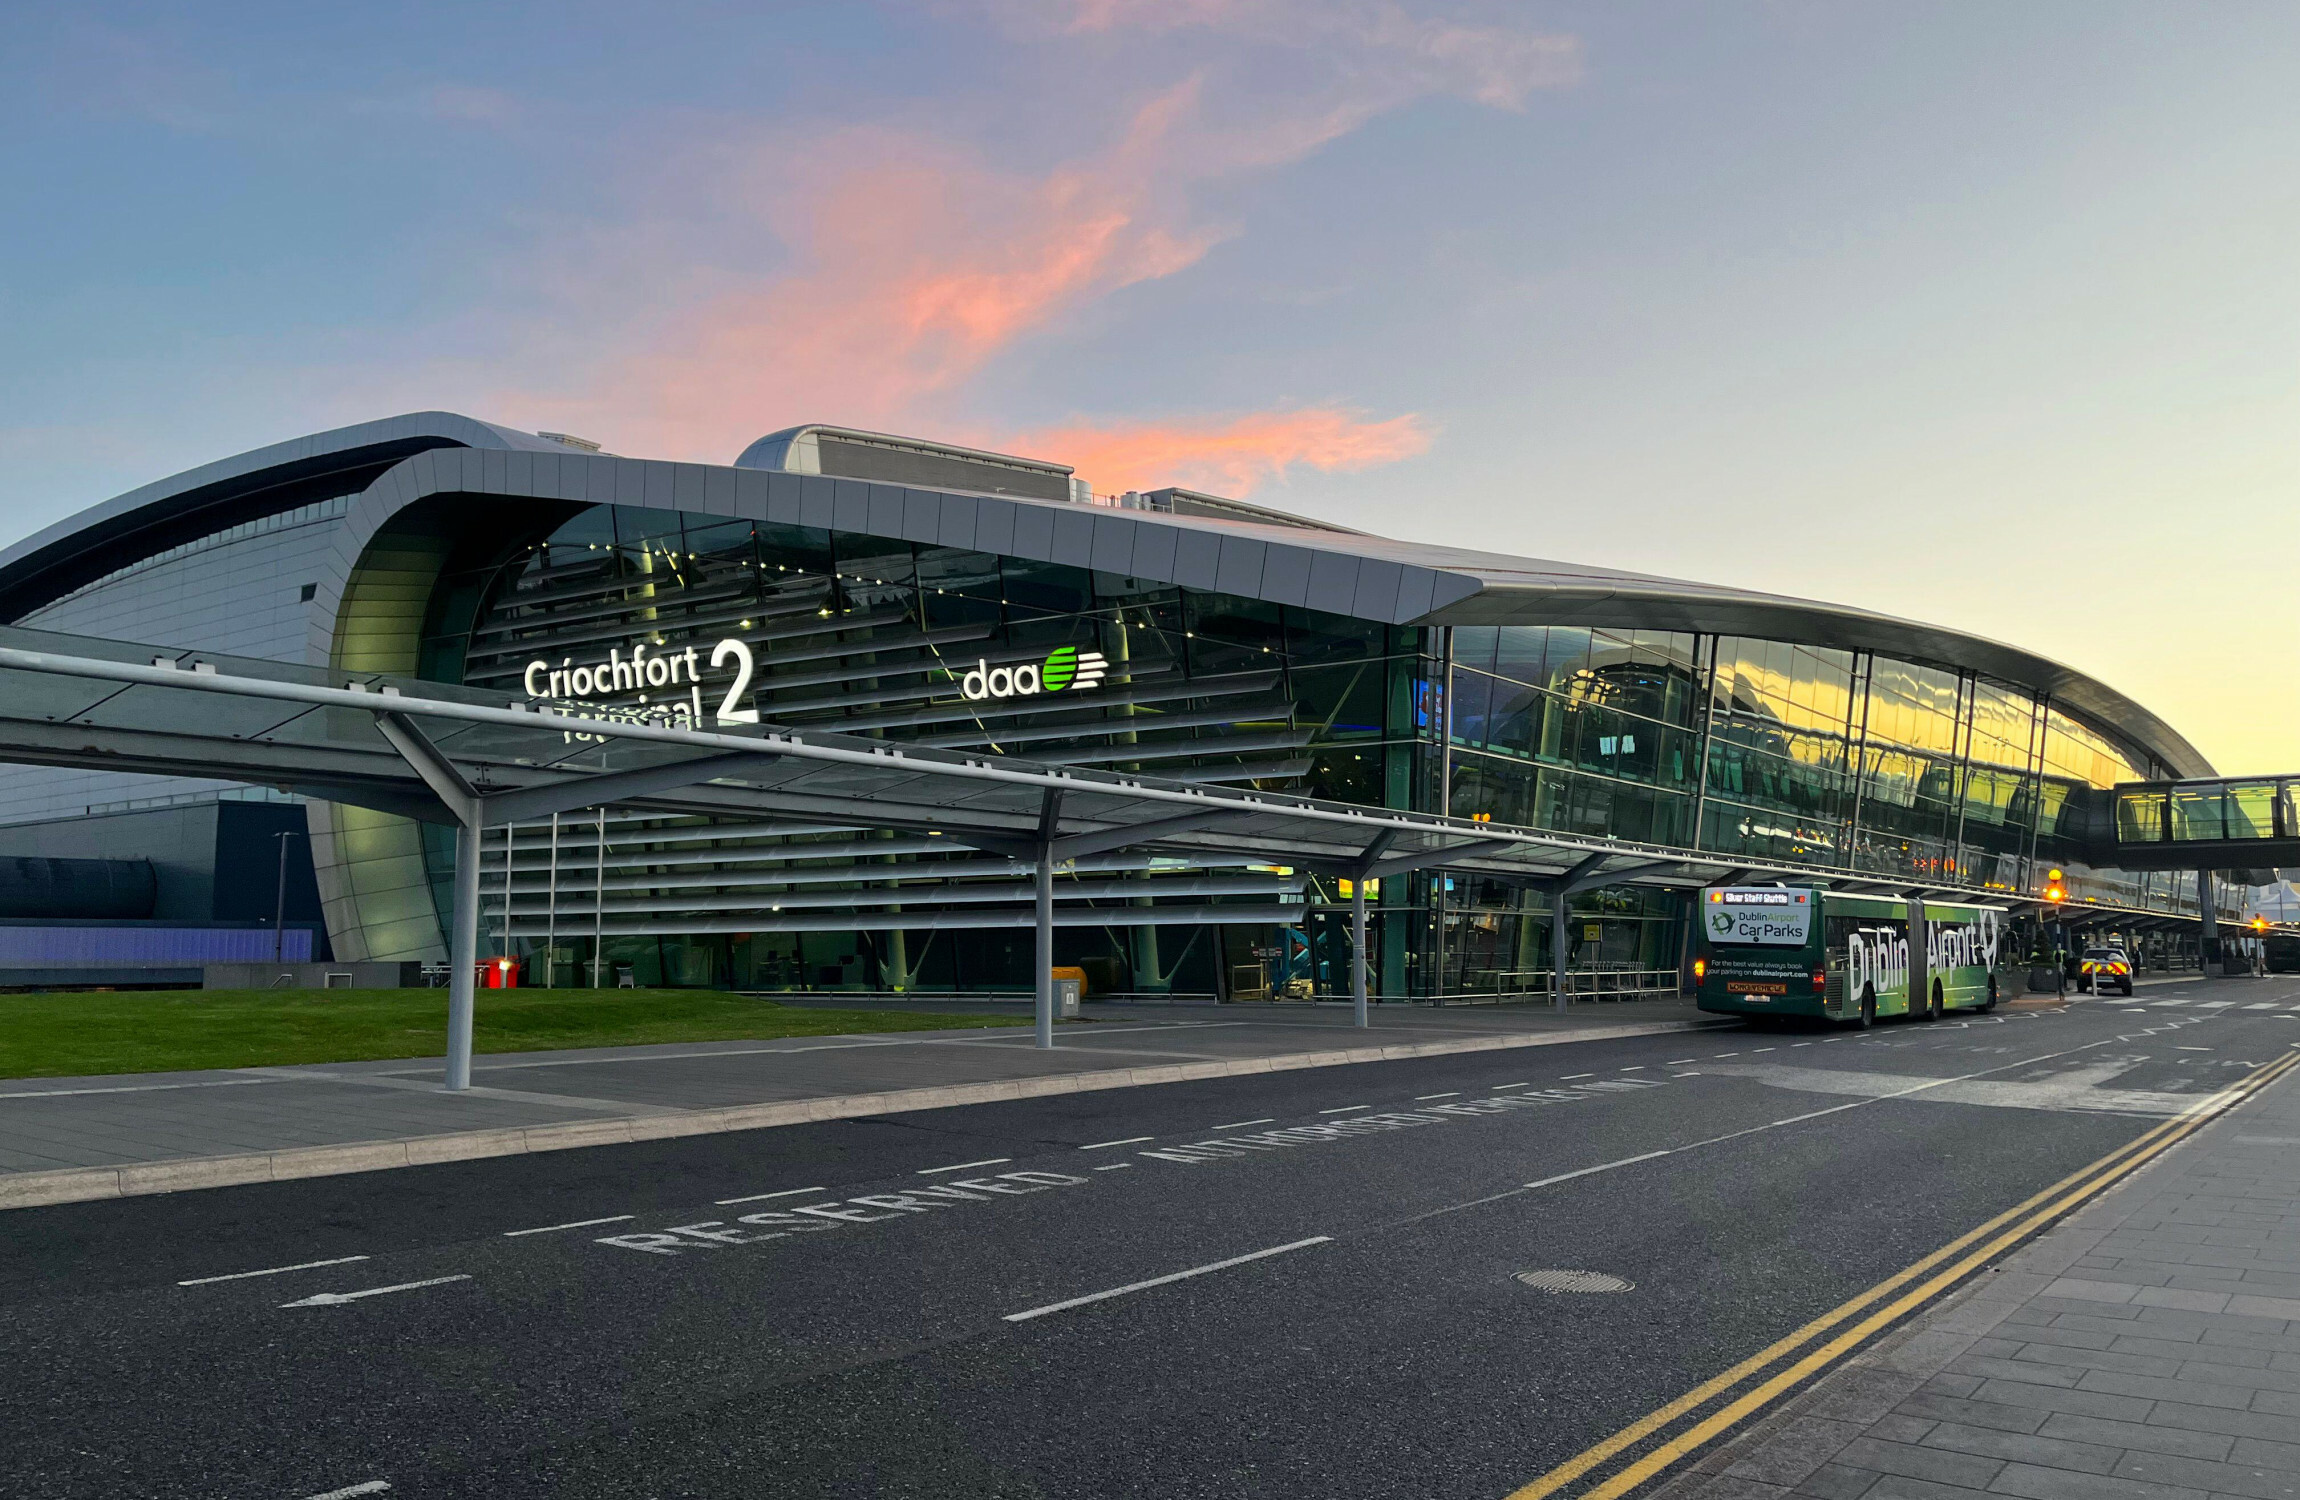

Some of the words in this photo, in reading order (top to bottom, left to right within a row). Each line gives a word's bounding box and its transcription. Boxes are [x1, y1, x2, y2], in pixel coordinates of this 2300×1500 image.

[524, 644, 701, 699] Críochfort
[710, 638, 760, 723] 2
[963, 658, 1041, 700] daa
[1745, 893, 1763, 902] Staff
[1764, 893, 1787, 903] Shuttle
[1739, 924, 1762, 936] Car
[1764, 924, 1803, 937] Parks
[1764, 962, 1786, 970] always
[1848, 926, 1910, 1002] Dublin
[1927, 917, 1978, 985] Airport
[1706, 968, 1720, 976] your
[1721, 968, 1743, 977] parking
[1752, 969, 1809, 978] dublinairport.com
[1752, 984, 1785, 992] VEHICLE
[593, 1171, 1091, 1255] RESERVED
[1138, 1112, 1449, 1164] AUTHORISED
